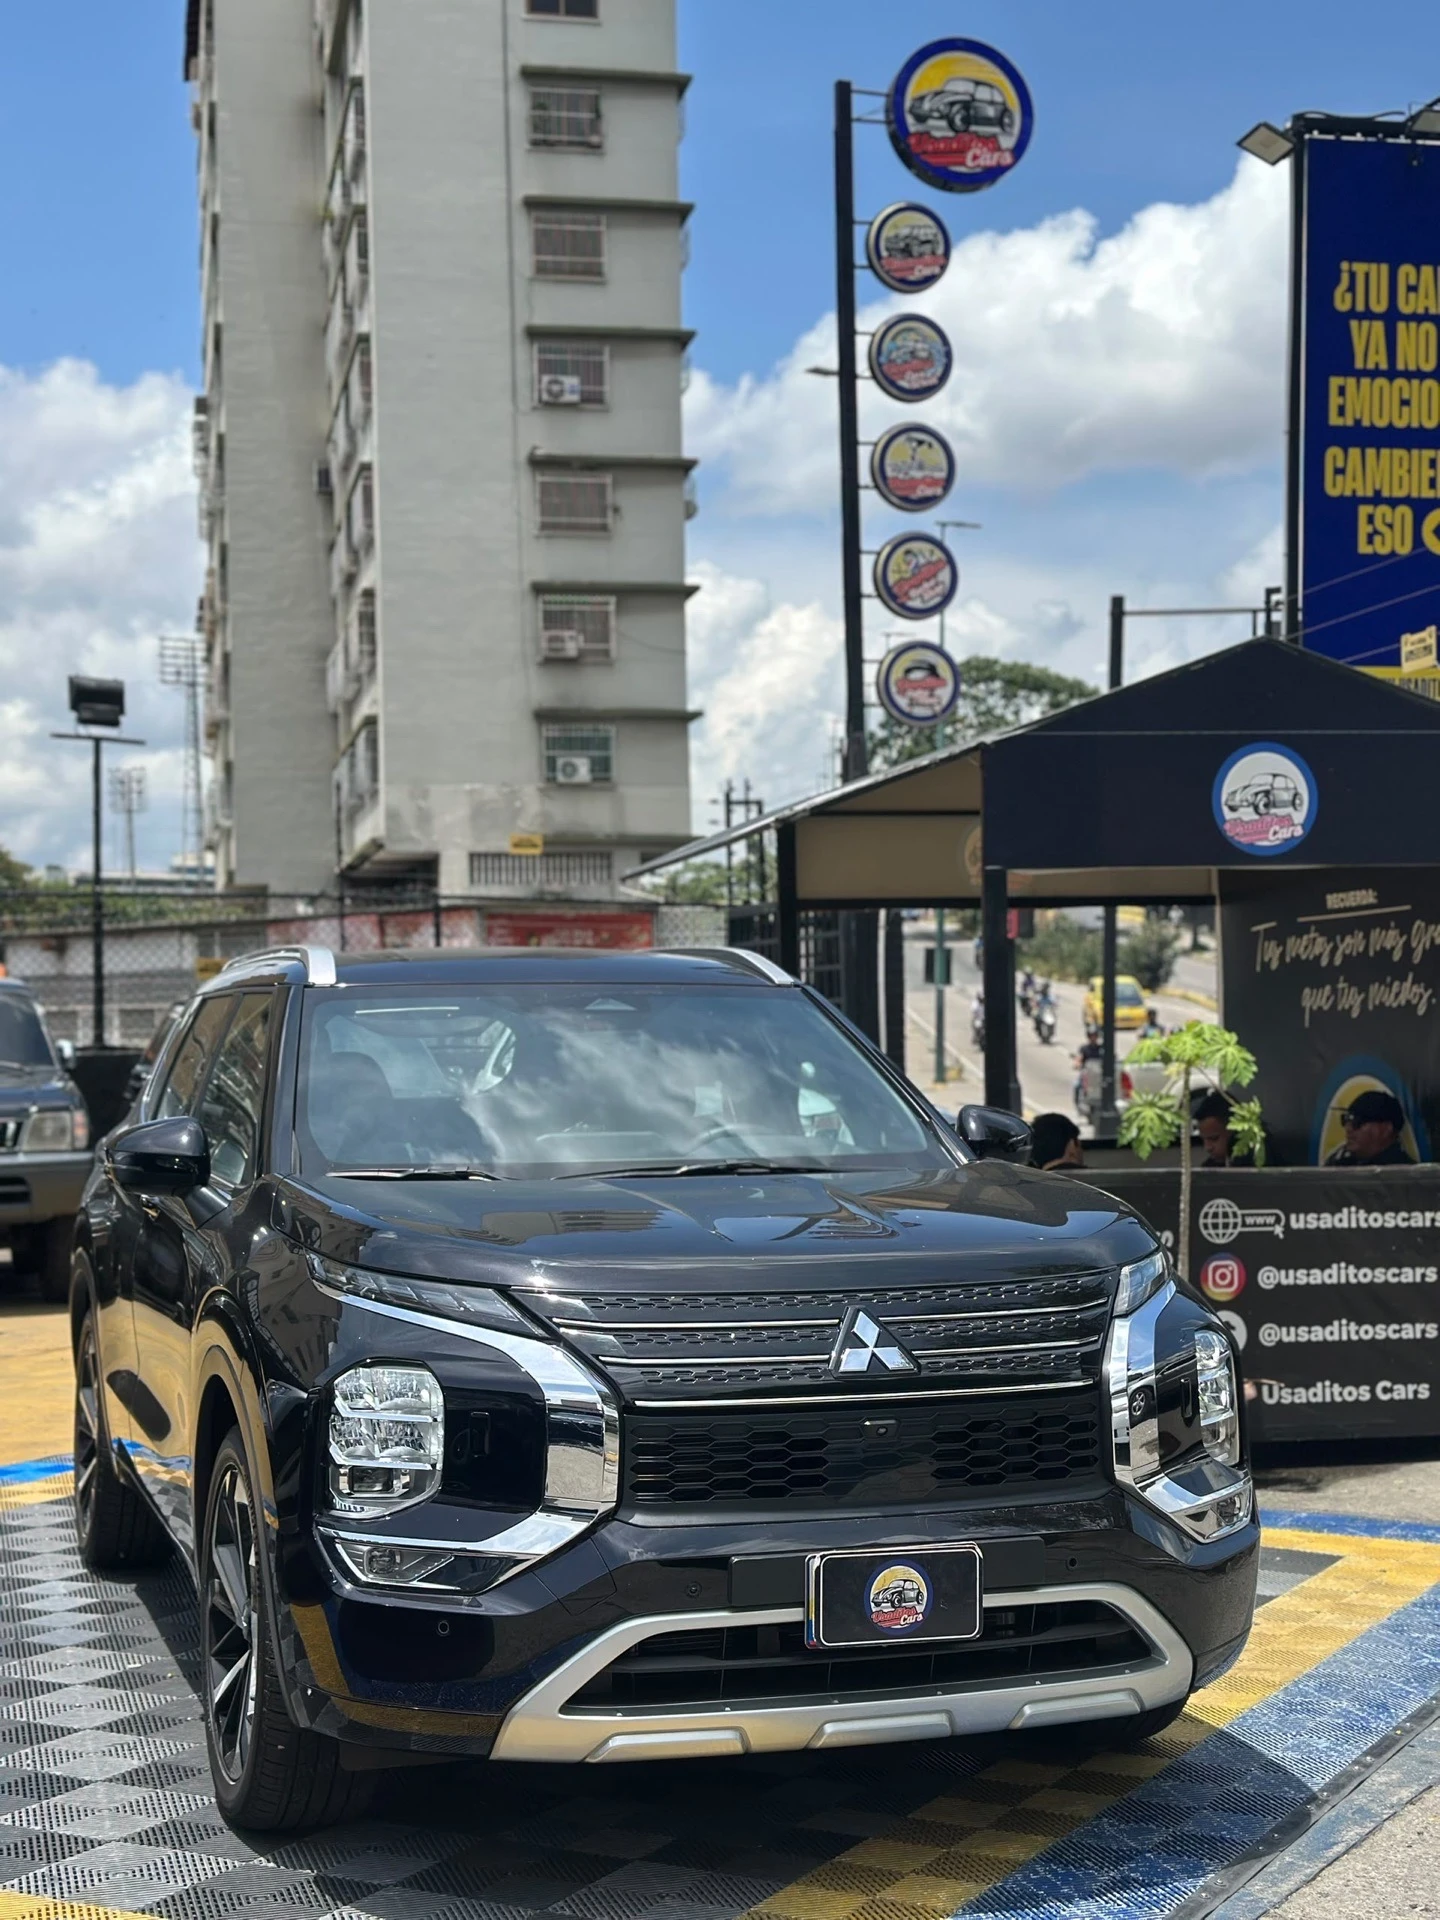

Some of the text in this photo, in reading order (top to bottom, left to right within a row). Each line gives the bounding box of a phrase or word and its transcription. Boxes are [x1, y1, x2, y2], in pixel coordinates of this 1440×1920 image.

[1333, 260, 1440, 315] ¿TU CA
[1349, 319, 1438, 372] YA NO
[1324, 445, 1440, 499] CAMBIE
[1357, 504, 1414, 556] ESO
[1268, 824, 1304, 841] Cars
[1245, 1205, 1440, 1229] www usaditoscars
[1257, 1261, 1438, 1290] @usaditoscars
[1258, 1318, 1439, 1347] @usaditoscars
[1261, 1380, 1431, 1405] Usaditos Cars
[900, 1613, 924, 1625] Cars
